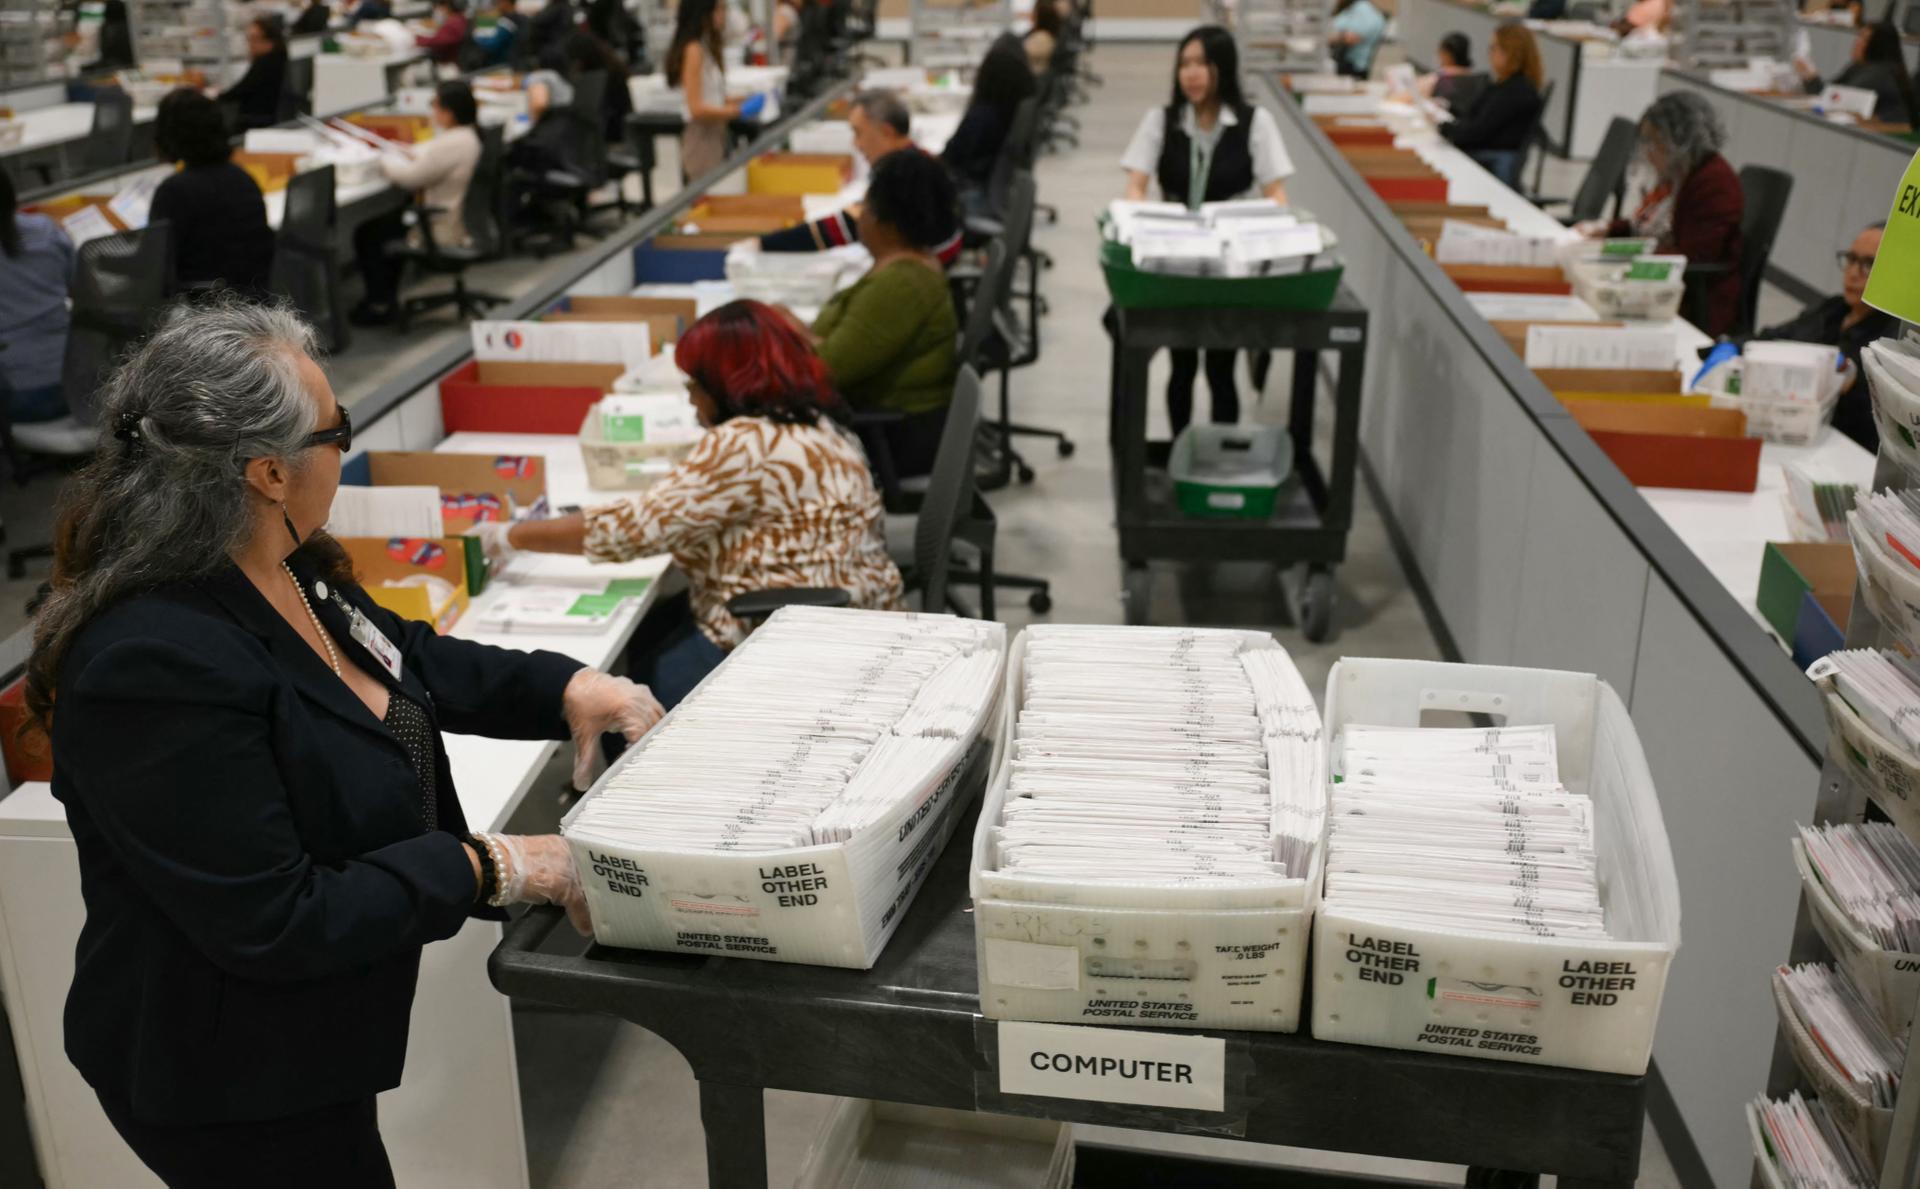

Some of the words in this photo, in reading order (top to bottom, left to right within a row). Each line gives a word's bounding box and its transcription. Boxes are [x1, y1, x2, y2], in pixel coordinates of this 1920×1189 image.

[1899, 184, 1920, 218] EX
[589, 850, 644, 872] LABEL
[593, 864, 649, 886] OTHER
[759, 863, 824, 879] LABEL
[607, 880, 642, 897] END
[762, 877, 828, 893] OTHER
[778, 894, 818, 907] END
[677, 932, 721, 942] UNITED
[723, 935, 769, 945] STATES
[1349, 933, 1420, 957] LABEL
[676, 940, 724, 950] POSTAL
[726, 943, 777, 954] SERVICE
[1242, 942, 1280, 952] WEIGHT
[1246, 951, 1265, 960] LBS
[1346, 949, 1420, 973] OTHER
[1562, 959, 1637, 975] LABEL
[1359, 966, 1404, 986] END
[1558, 975, 1636, 991] OTHER
[1088, 999, 1139, 1009] UNITED
[1141, 1001, 1193, 1012] STATES
[1571, 991, 1618, 1006] END
[1082, 1008, 1136, 1018] POSTAL
[1138, 1010, 1199, 1021] SERVICE
[1424, 1023, 1480, 1038] UNITED
[1481, 1030, 1538, 1044] STATES
[1416, 1033, 1475, 1048] POSTAL
[1477, 1040, 1543, 1056] SERVICE
[1030, 1051, 1193, 1084] COMPUTER
